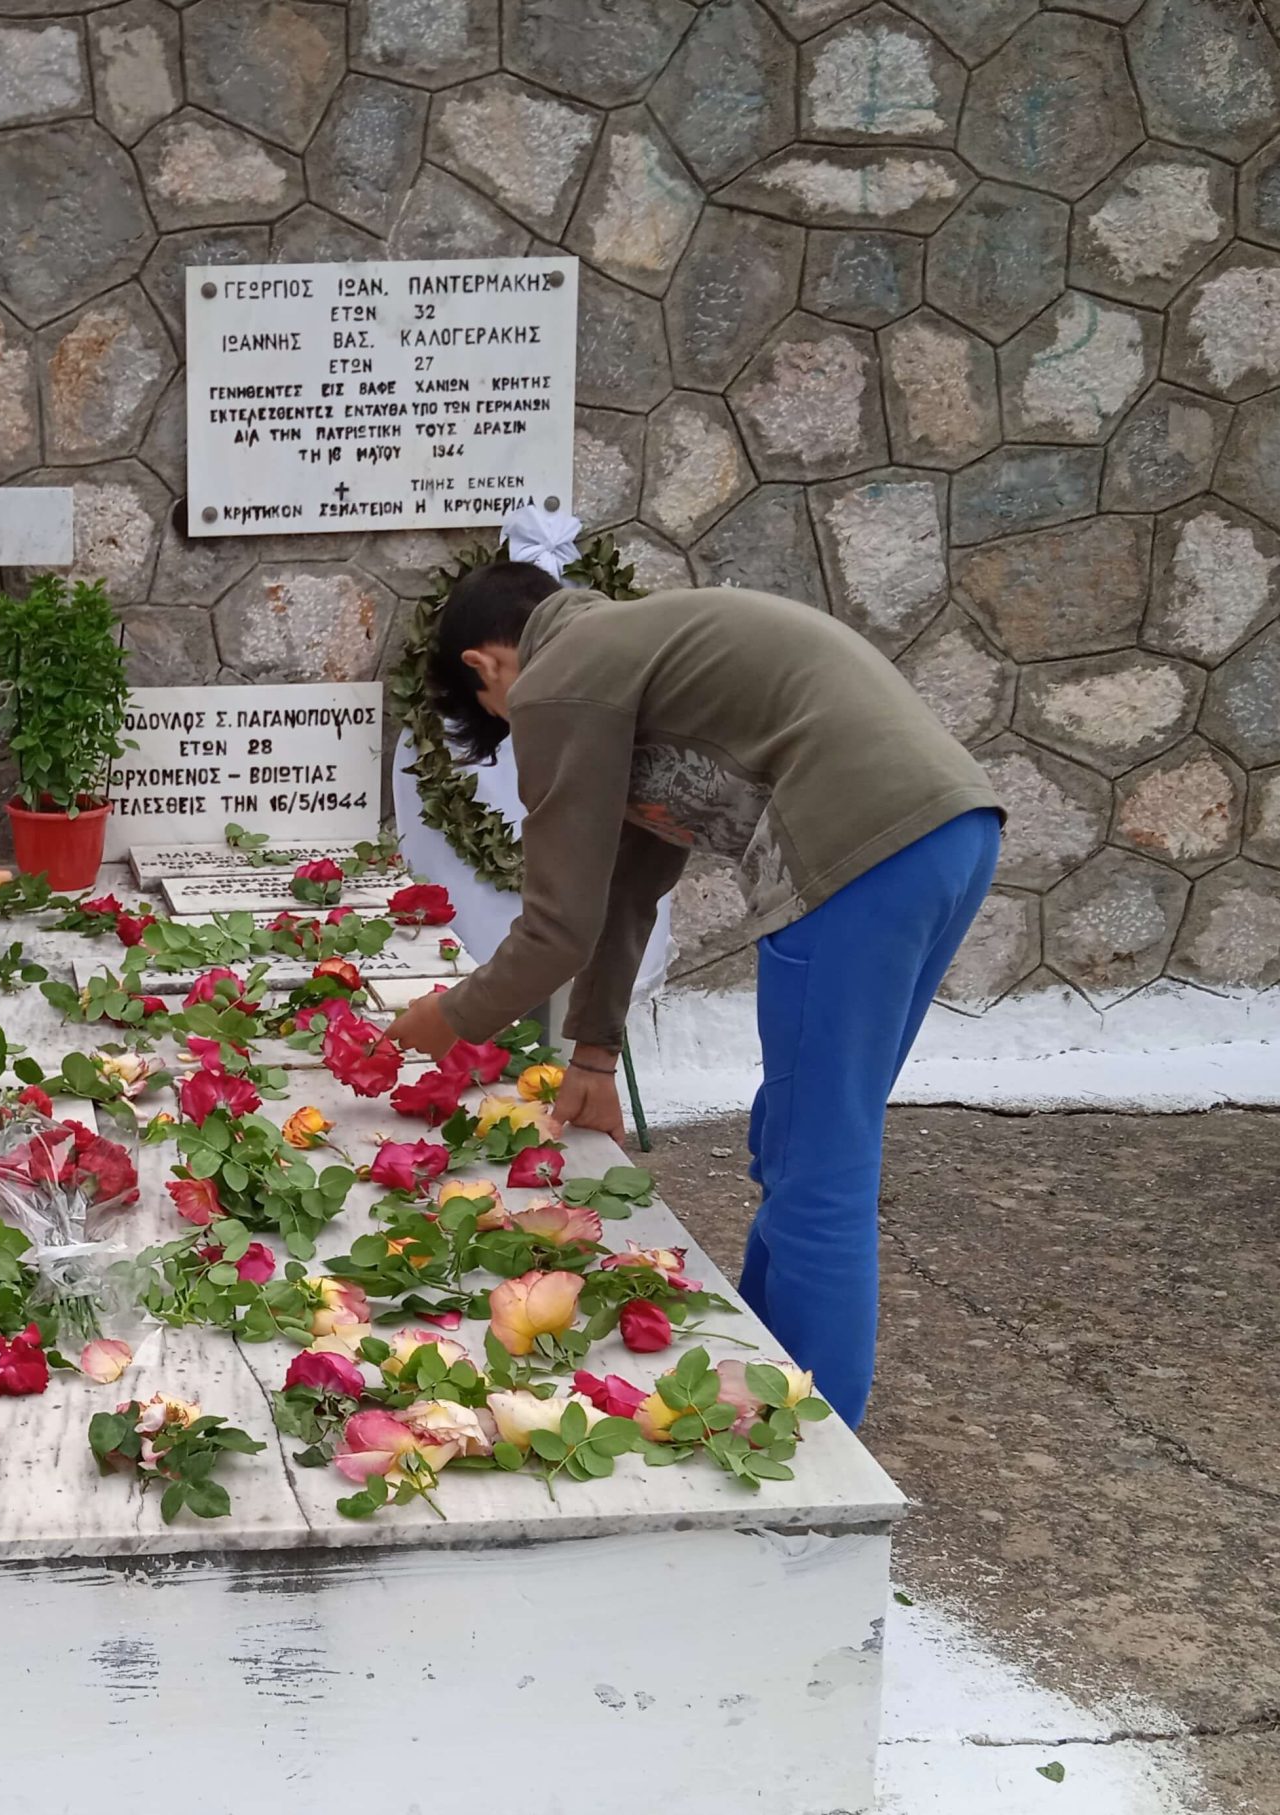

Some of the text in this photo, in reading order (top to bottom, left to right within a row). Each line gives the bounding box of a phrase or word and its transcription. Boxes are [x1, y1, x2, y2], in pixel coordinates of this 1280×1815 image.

[225, 273, 552, 299] ΓΕΩΡΓΙΟΣ ΙΩΑΝ. ΠΑΝΤΕΡΜΑΚΗΣ
[331, 305, 436, 322] ΕΤΩΝ 32
[222, 326, 541, 352] ΙΩΑΝΝΗΣ ΒΑΣ. ΚΑΛΟΓΕΡΑΚΗΣ
[330, 357, 434, 374] ΕΤΩΝ 27
[210, 376, 551, 400] ΓΕΝΗΘΕΝΤΕΣ ΕΙΣ ΒΑΦΕ ΧΑΝΙΩΝ ΚΡΗΤΗΣ
[344, 403, 407, 418] ΕΝΤΑΥΘΑ
[412, 402, 438, 416] ΥΠΟ
[444, 401, 470, 414] ΤΩΝ
[476, 398, 550, 413] ΓΕΡΜΑΝΩΝ
[234, 429, 260, 447] ΔΙΑ
[270, 428, 301, 441] ΤΗΝ
[316, 425, 401, 441] ΠΑΤΡΙΩΤΙΚΗ
[416, 423, 457, 438] ΤΟΥΣ
[299, 449, 321, 463] ΤΗ
[411, 476, 524, 492] ΤΙΜΗΣ ΕΝΕΚΕΝ
[319, 501, 403, 518] ΣΩΜΑΤΕΙΟΝ
[416, 498, 426, 513] Η
[125, 707, 376, 740] ΟΔΟΥΛΟΣ Σ. ΠΑΓΑΝΟΠΟΥΛΟΣ
[180, 739, 272, 757] ΕΤΩΝ 28
[250, 765, 337, 785] ΒΟΙΩΤΙΑΣ
[109, 791, 368, 816] ΤΕΛΕΣΘΕΙΣ ΤΗΝ 16/5/1944
